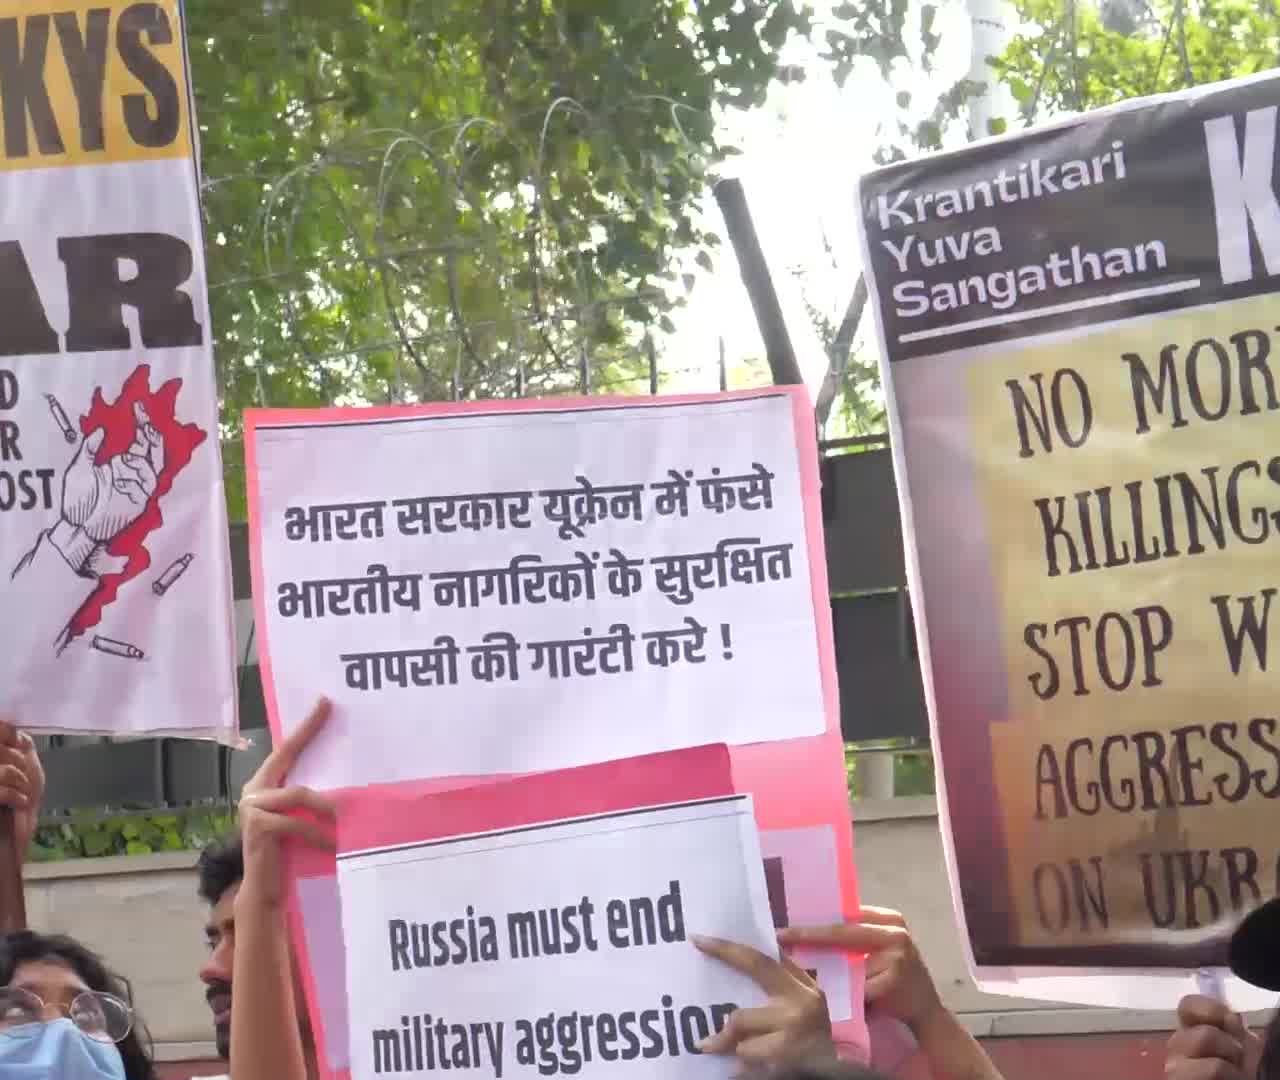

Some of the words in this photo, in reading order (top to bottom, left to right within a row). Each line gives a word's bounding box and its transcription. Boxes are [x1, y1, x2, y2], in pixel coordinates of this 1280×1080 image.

[876, 140, 1127, 230] Krantikari
[882, 222, 1003, 273] Yuva
[892, 240, 1167, 319] Sangathan
[1005, 366, 1094, 459] NO
[284, 499, 385, 543] भारत
[392, 489, 533, 535] सरकार
[538, 475, 643, 538] यूक्रेन
[650, 469, 692, 517] में
[696, 461, 775, 514] फंसे
[277, 563, 422, 619] भारतीय
[429, 551, 600, 610] नागरिकों
[602, 548, 643, 598] के
[650, 536, 794, 606] सुरक्षित
[340, 635, 460, 691] वापसी
[466, 635, 520, 682] की
[526, 624, 633, 680] गारंटी
[640, 616, 708, 666] करे
[1023, 605, 1173, 700] STOP
[388, 905, 498, 972] Russia
[507, 895, 598, 960] must
[605, 879, 687, 948] end
[1032, 857, 1108, 936] ON
[372, 1015, 504, 1078] military
